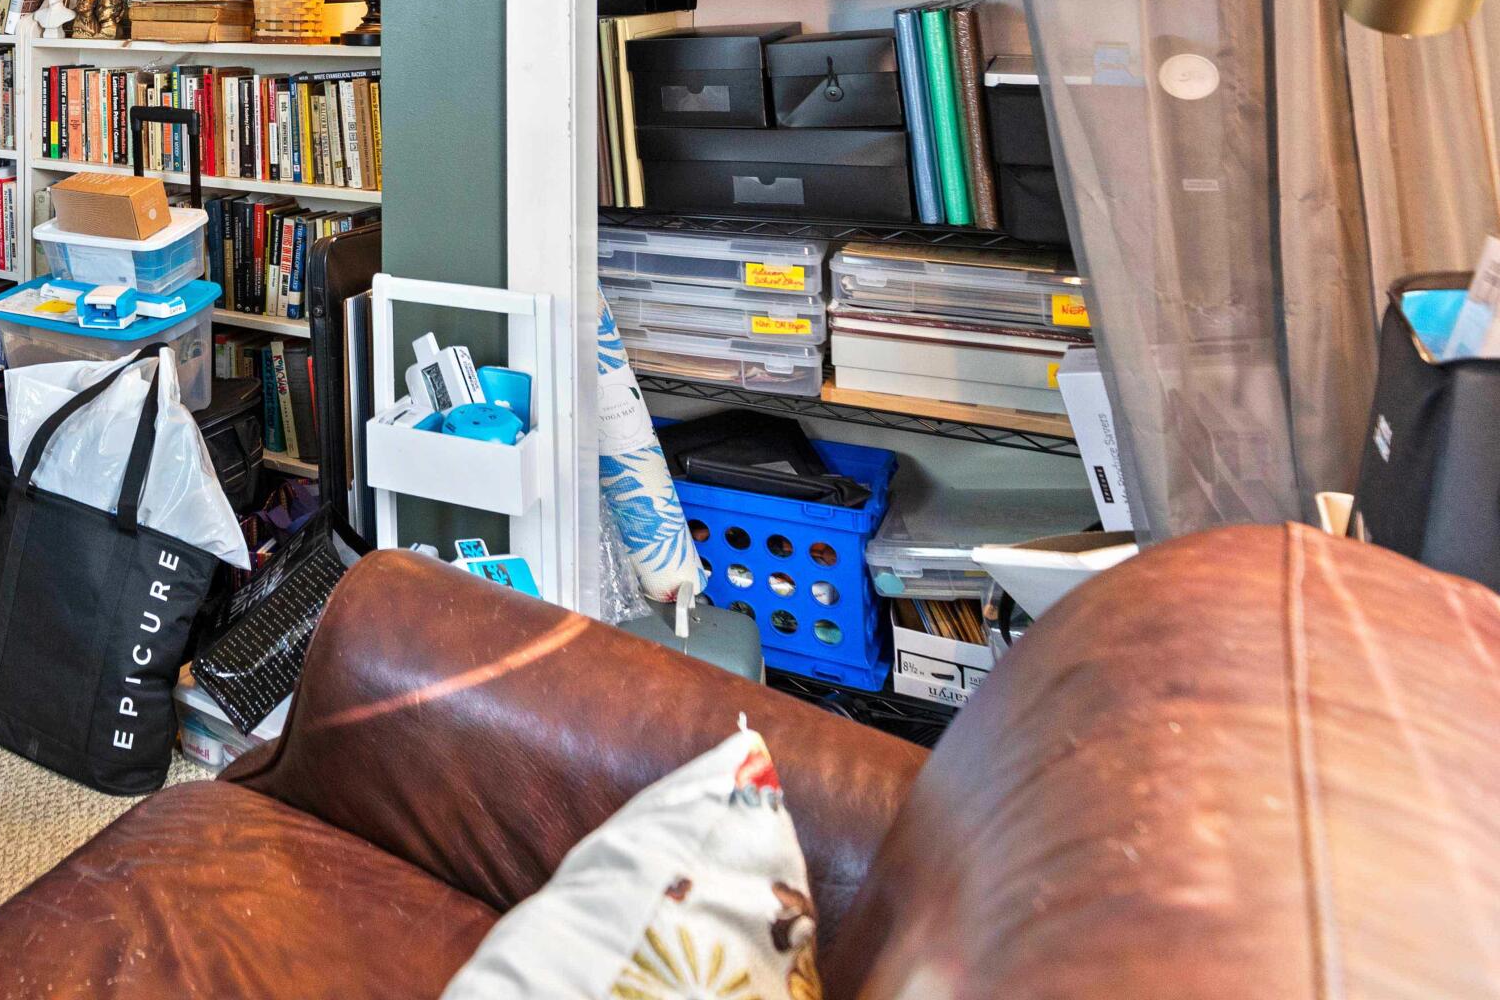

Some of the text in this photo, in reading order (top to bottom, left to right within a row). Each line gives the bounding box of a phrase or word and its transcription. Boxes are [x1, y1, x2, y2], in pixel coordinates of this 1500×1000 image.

[283, 225, 293, 246] WRITERS
[283, 254, 292, 263] THE
[281, 263, 291, 274] LEFT
[599, 408, 636, 422] YOGA MAT
[1098, 414, 1115, 445] Savers
[112, 549, 180, 750] EPICURE
